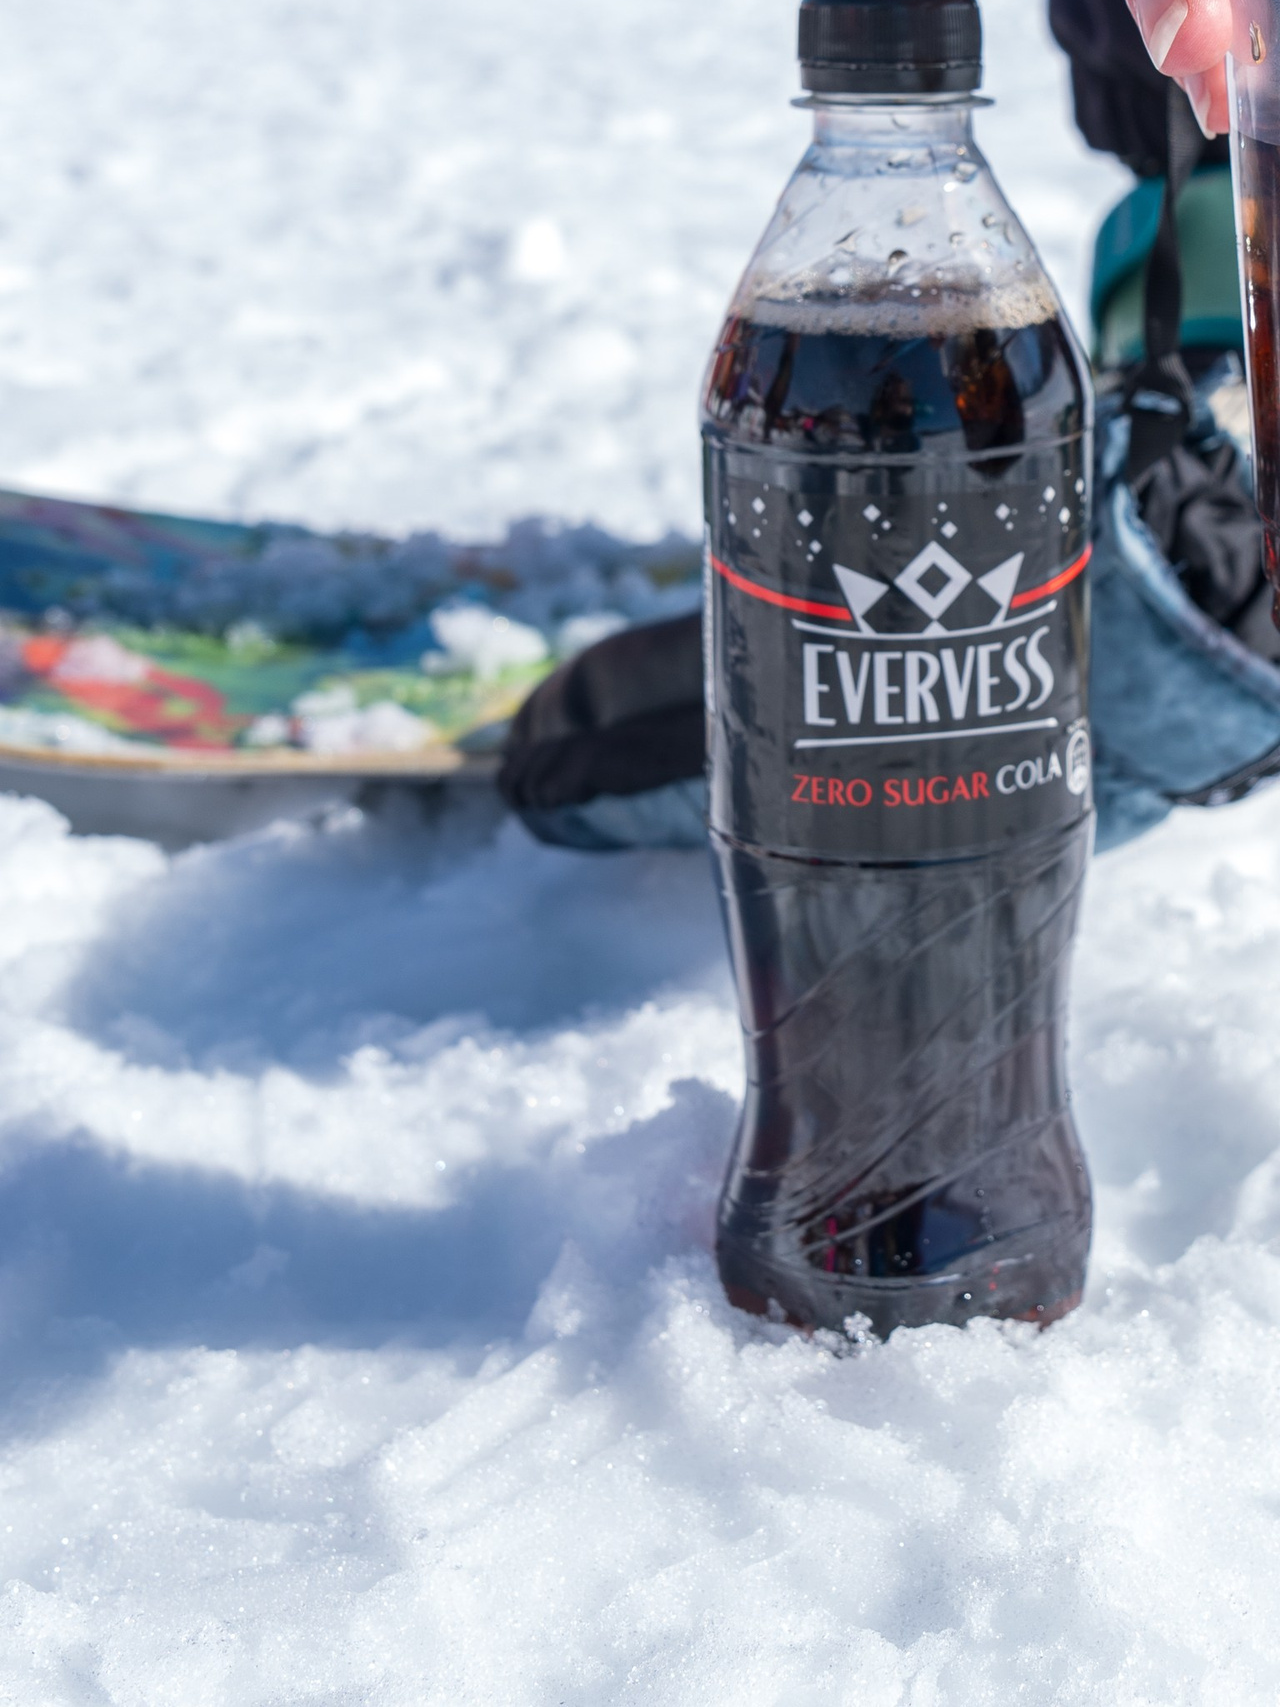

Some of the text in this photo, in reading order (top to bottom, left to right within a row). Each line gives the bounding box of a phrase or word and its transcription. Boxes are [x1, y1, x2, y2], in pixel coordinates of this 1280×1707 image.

[803, 625, 1054, 726] EVERVESS
[791, 773, 873, 806] ZERO
[883, 771, 990, 807] SUGAR
[995, 751, 1062, 794] COLA
